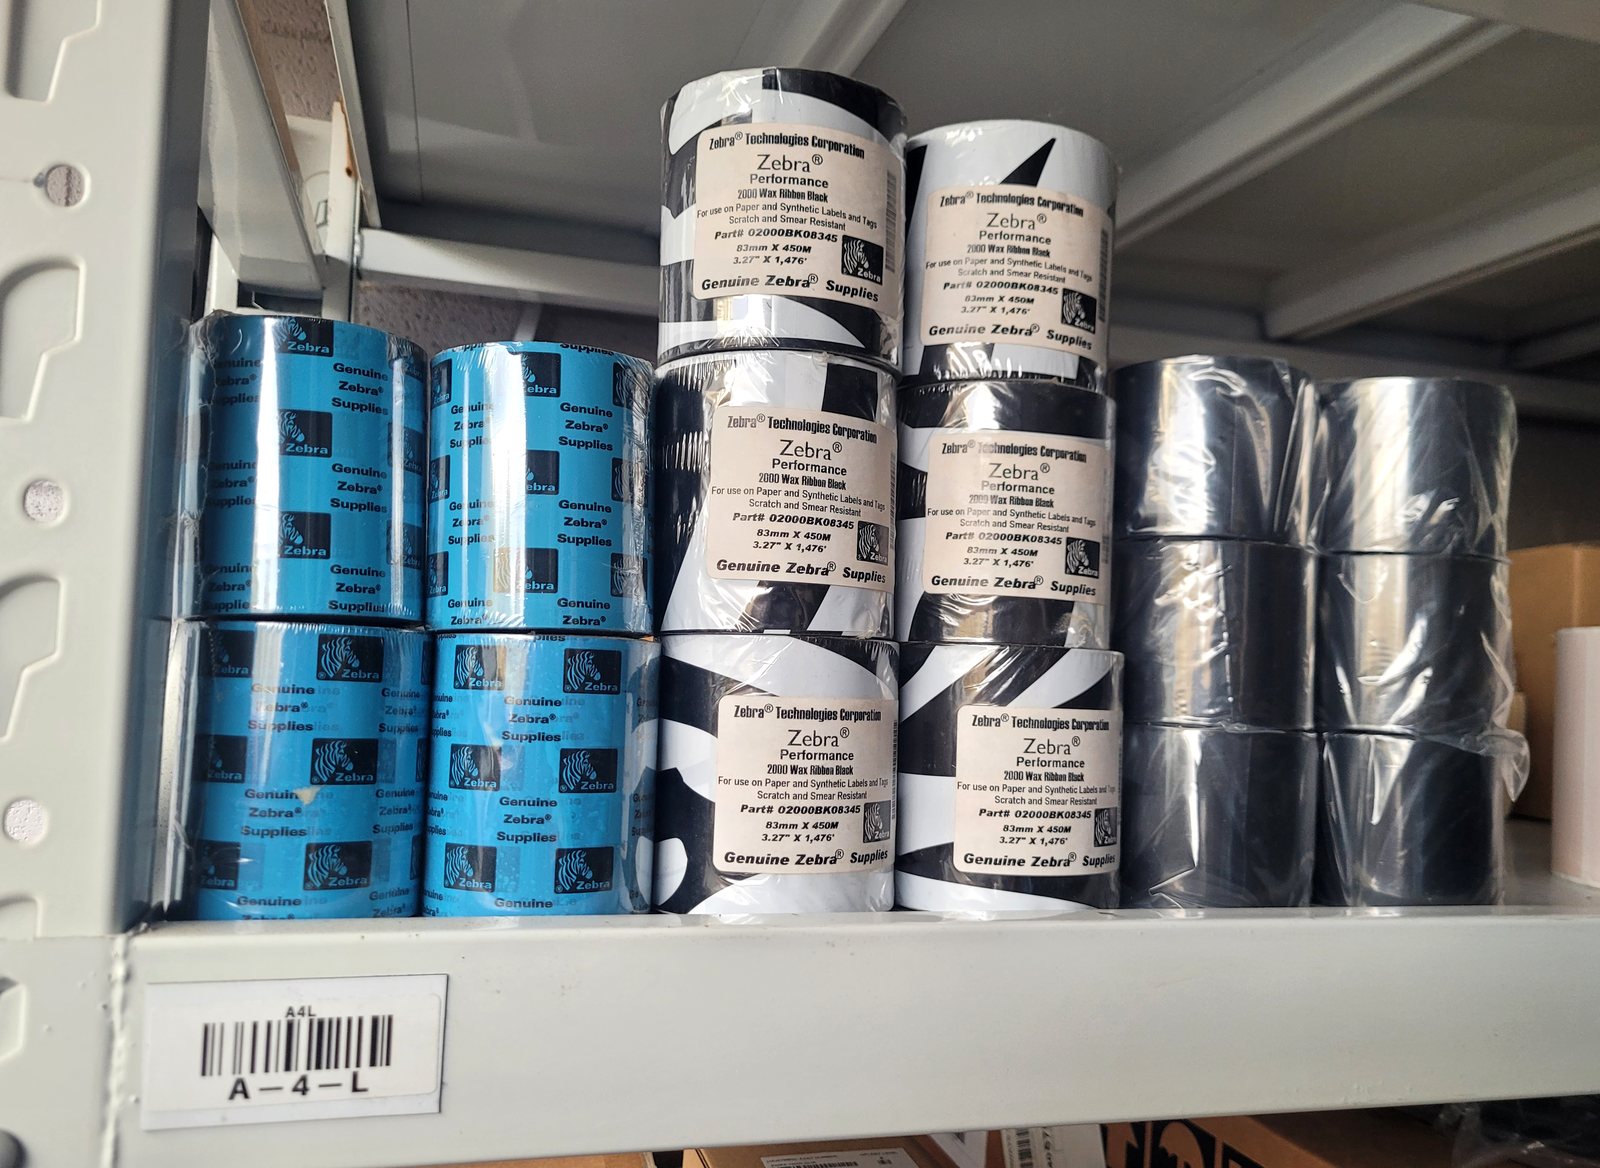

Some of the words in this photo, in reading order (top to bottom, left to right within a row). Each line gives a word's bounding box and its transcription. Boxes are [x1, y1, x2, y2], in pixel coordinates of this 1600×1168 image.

[746, 133, 809, 147] Technologies
[812, 136, 864, 159] Corporation
[750, 174, 828, 188] Performance
[738, 190, 757, 199] 2000
[759, 189, 777, 198] Wax
[779, 189, 805, 200] Ribbon
[808, 193, 828, 202] Black
[697, 210, 708, 218] For
[710, 207, 722, 216] use
[736, 204, 759, 213] Paper
[762, 203, 777, 211] and
[780, 203, 819, 214] Synthetic
[822, 207, 846, 219] Labels
[848, 214, 860, 223] and
[729, 215, 759, 224] Scratch
[762, 215, 777, 223] and
[780, 215, 807, 224] Smear
[810, 219, 846, 230] Resistant
[714, 230, 743, 239] Part#
[748, 229, 838, 242] 02000BK08345
[979, 231, 1051, 245] Performance
[783, 245, 811, 253] 450M
[702, 278, 759, 290] Genuine
[826, 280, 879, 302] Supplies
[943, 282, 972, 290] Part#
[976, 281, 1058, 294] 02000BK08345
[929, 325, 985, 336] Genuine
[1047, 330, 1092, 350] Supplies
[288, 341, 330, 354] Zebra
[333, 362, 388, 381] Genuine
[332, 398, 388, 416] Supplies
[560, 402, 613, 417] Genuine
[768, 417, 830, 434] Technologies
[833, 424, 877, 443] Corporation
[286, 443, 328, 455] Zebra
[558, 436, 613, 450] Supplies
[772, 459, 847, 475] Performance
[759, 473, 779, 483] 2000
[781, 474, 799, 485] Wax
[802, 476, 826, 487] Ribbon
[828, 480, 846, 490] Black
[981, 481, 1055, 494] Performance
[757, 487, 781, 497] Paper
[784, 489, 799, 497] and
[802, 490, 838, 502] Synthetic
[840, 494, 862, 506] Labels
[863, 499, 873, 507] and
[558, 500, 612, 513] Genuine
[749, 500, 781, 509] Scratch
[784, 501, 799, 509] and
[802, 502, 827, 512] Smear
[830, 505, 861, 516] Resistant
[733, 513, 765, 522] Part#
[769, 514, 854, 529] 02000BK08345
[557, 534, 612, 546] Supplies
[757, 529, 789, 538] 83mm
[804, 533, 831, 541] 450M
[979, 533, 1062, 545] 02000BK08345
[284, 546, 326, 556] Zebra
[717, 560, 780, 572] Genuine
[843, 567, 886, 583] Supplies
[932, 576, 988, 587] Genuine
[1051, 581, 1096, 595] Supplies
[342, 669, 380, 679] Zebra
[585, 682, 618, 692] Zebra
[504, 696, 561, 707] Genuine
[776, 707, 837, 722] Technologies
[840, 708, 881, 723] Corporation
[1012, 716, 1069, 731] Technologies
[1072, 718, 1109, 732] Corporation
[502, 731, 561, 742] Supplies
[780, 749, 854, 760] Performance
[1016, 757, 1085, 768] Performance
[767, 764, 787, 774] 2000
[790, 765, 808, 775] Wax
[810, 765, 834, 775] Ribbon
[836, 766, 853, 775] Black
[336, 773, 374, 782] Zebra
[718, 776, 731, 785] For
[734, 778, 749, 786] use
[765, 779, 790, 789] Paper
[793, 779, 808, 788] and
[811, 779, 846, 790] Synthetic
[848, 778, 868, 787] Labels
[581, 782, 614, 790] Zebra
[500, 797, 557, 807] Genuine
[757, 791, 790, 799] Scratch
[810, 792, 835, 800] Smear
[838, 791, 867, 799] Resistant
[740, 805, 773, 813] Part#
[778, 805, 860, 814] 02000BK08345
[979, 809, 1010, 817] Part#
[1014, 810, 1091, 819] 02000BK08345
[241, 827, 307, 838] Supplies
[497, 832, 557, 842] Supplies
[724, 852, 789, 865] Genuine
[850, 849, 888, 863] Supplies
[964, 853, 1025, 866] Genuine
[1082, 853, 1115, 867] Supplies
[328, 876, 368, 886] Zebra
[286, 1006, 316, 1018] A4L
